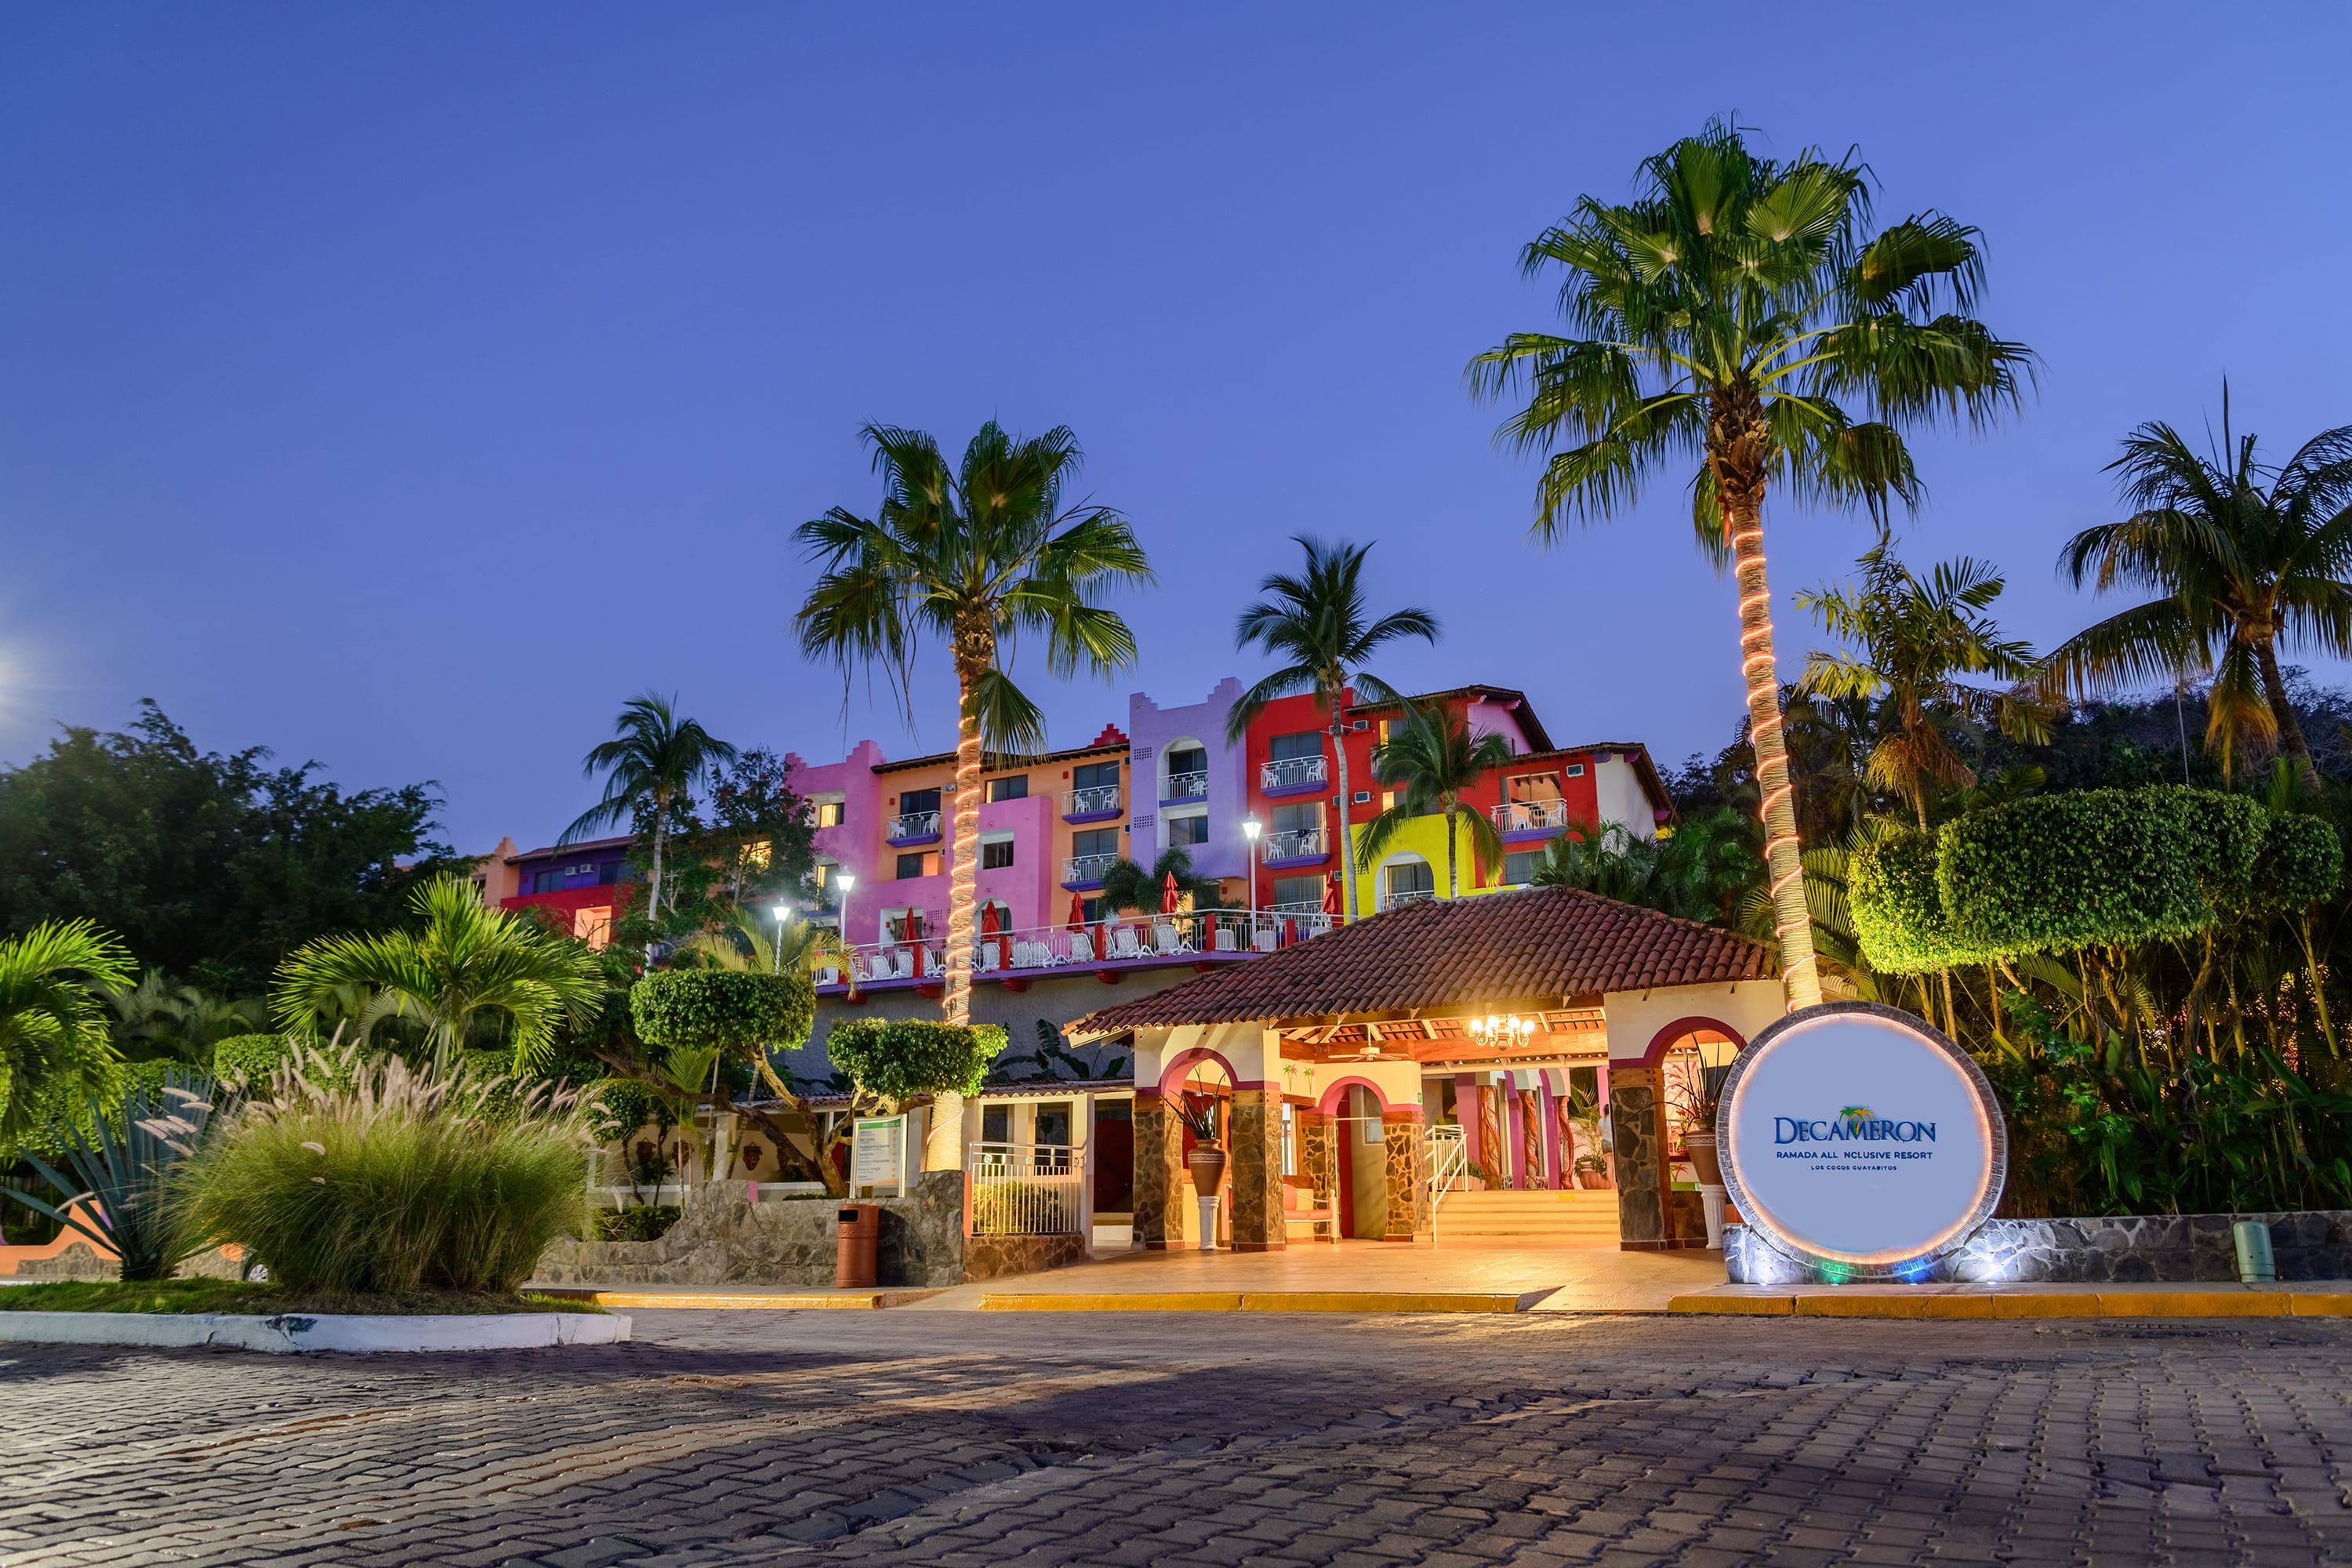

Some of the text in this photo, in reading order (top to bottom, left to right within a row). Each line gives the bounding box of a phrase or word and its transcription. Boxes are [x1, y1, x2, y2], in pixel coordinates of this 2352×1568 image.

[1773, 1116, 1937, 1145] DECAMERON
[1776, 1151, 1819, 1160] RAMADA
[1820, 1151, 1838, 1160] ALL
[1893, 1151, 1933, 1160] RESORT
